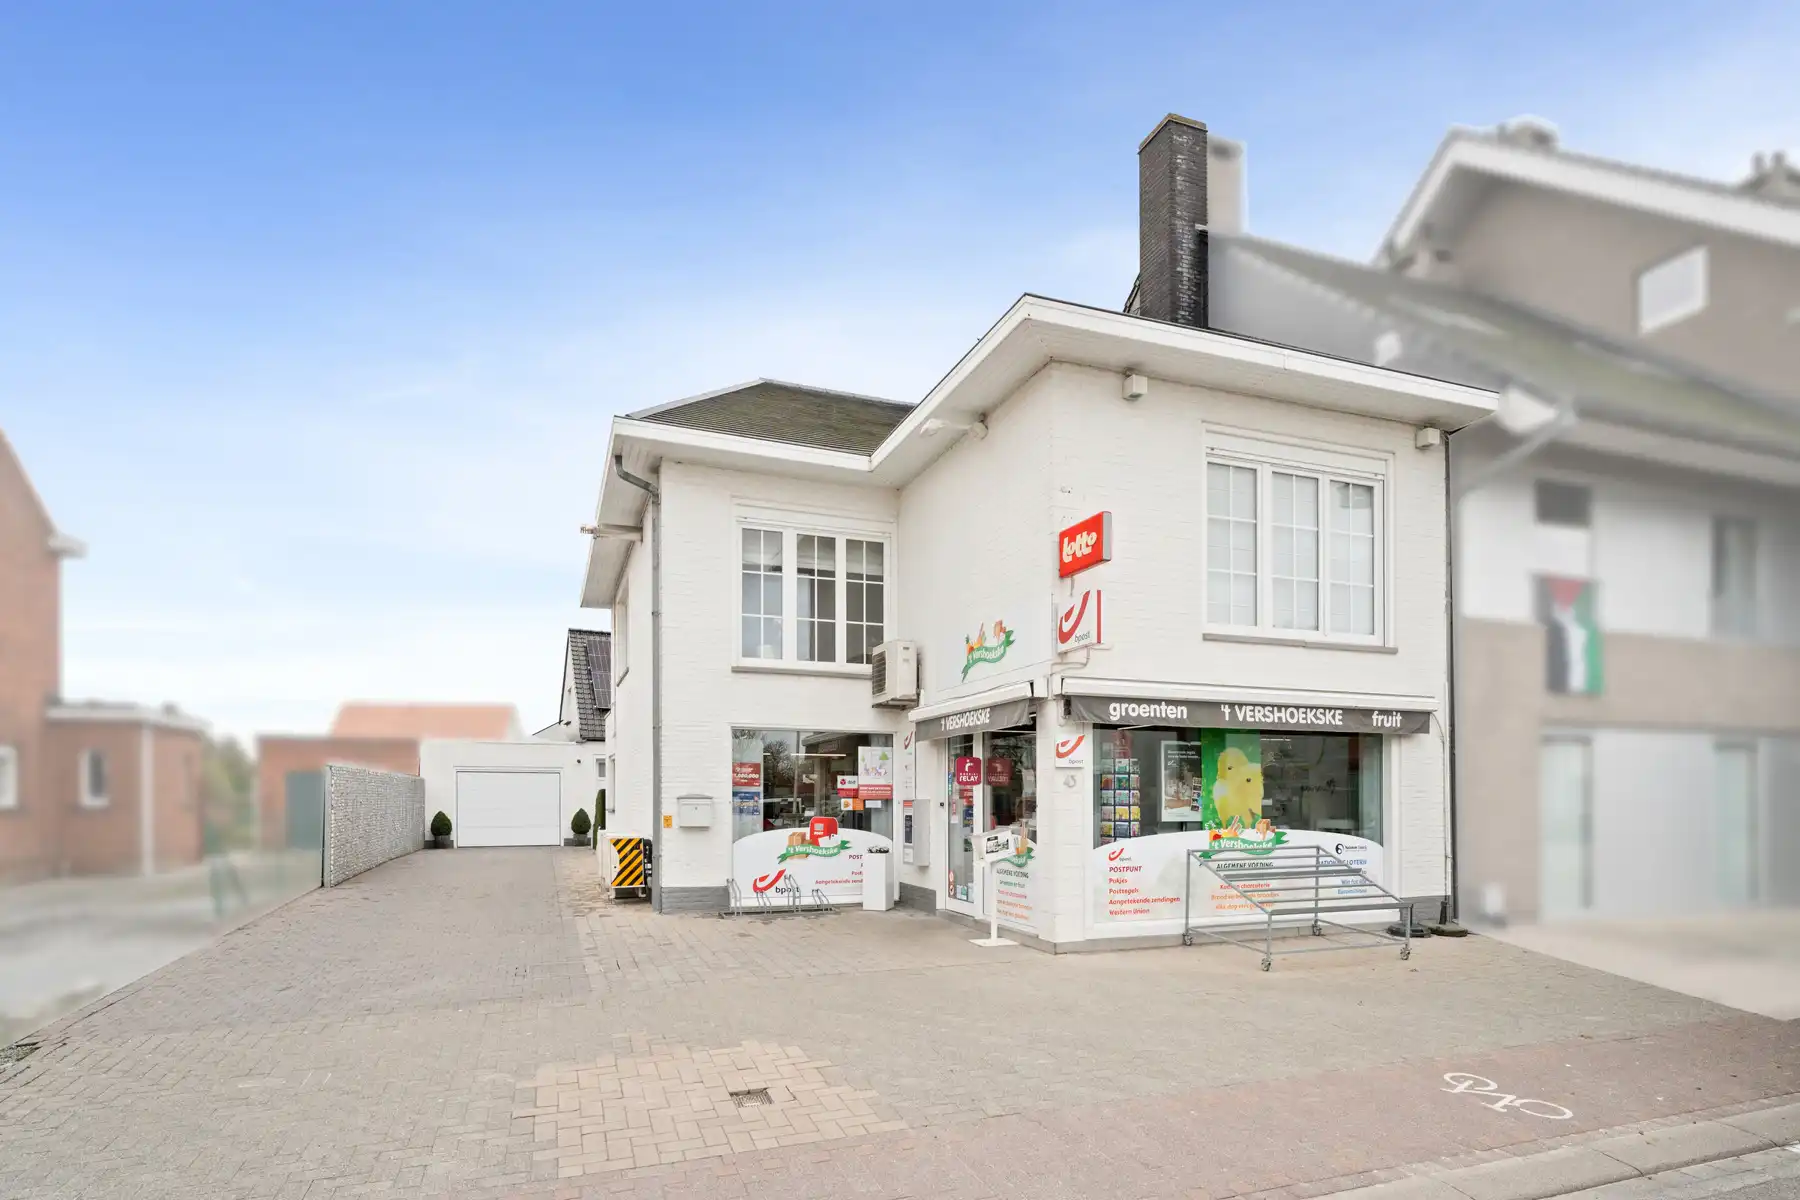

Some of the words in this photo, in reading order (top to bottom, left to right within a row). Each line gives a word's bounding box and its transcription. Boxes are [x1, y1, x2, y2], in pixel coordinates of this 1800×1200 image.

[1074, 631, 1091, 644] bpost
[946, 708, 991, 731] VERSHOEKSKE
[1109, 702, 1187, 720] groenten
[1221, 705, 1231, 722] 't
[1234, 705, 1343, 726] VERSHOEKSKE
[1372, 710, 1402, 728] fruit
[795, 846, 838, 855] Vershoekske
[775, 886, 800, 895] bpot
